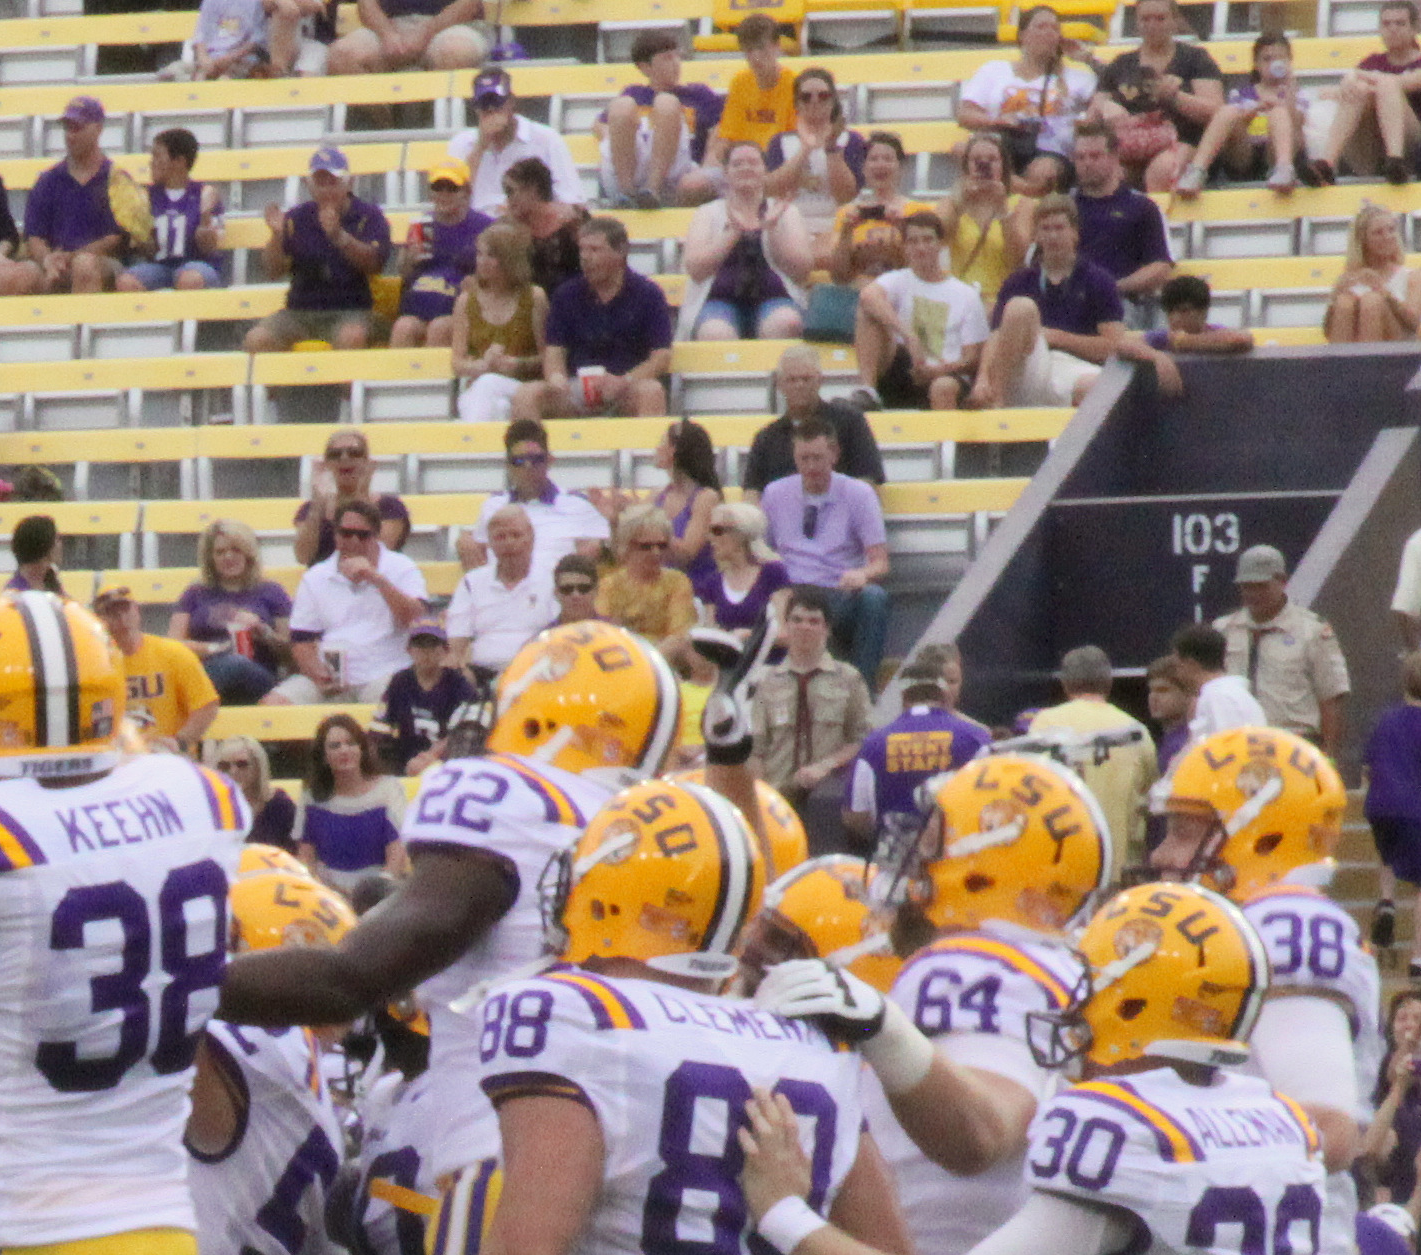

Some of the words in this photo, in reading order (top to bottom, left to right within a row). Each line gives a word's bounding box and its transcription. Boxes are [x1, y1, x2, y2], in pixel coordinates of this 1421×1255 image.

[1173, 513, 1240, 555] 103
[125, 674, 164, 700] SU
[65, 790, 184, 853] KEEHN
[416, 768, 508, 833] 22
[34, 859, 225, 1092] 38
[1260, 909, 1345, 979] 38
[480, 989, 554, 1065] 88
[915, 968, 1002, 1039] 64
[1030, 1107, 1126, 1191] 30
